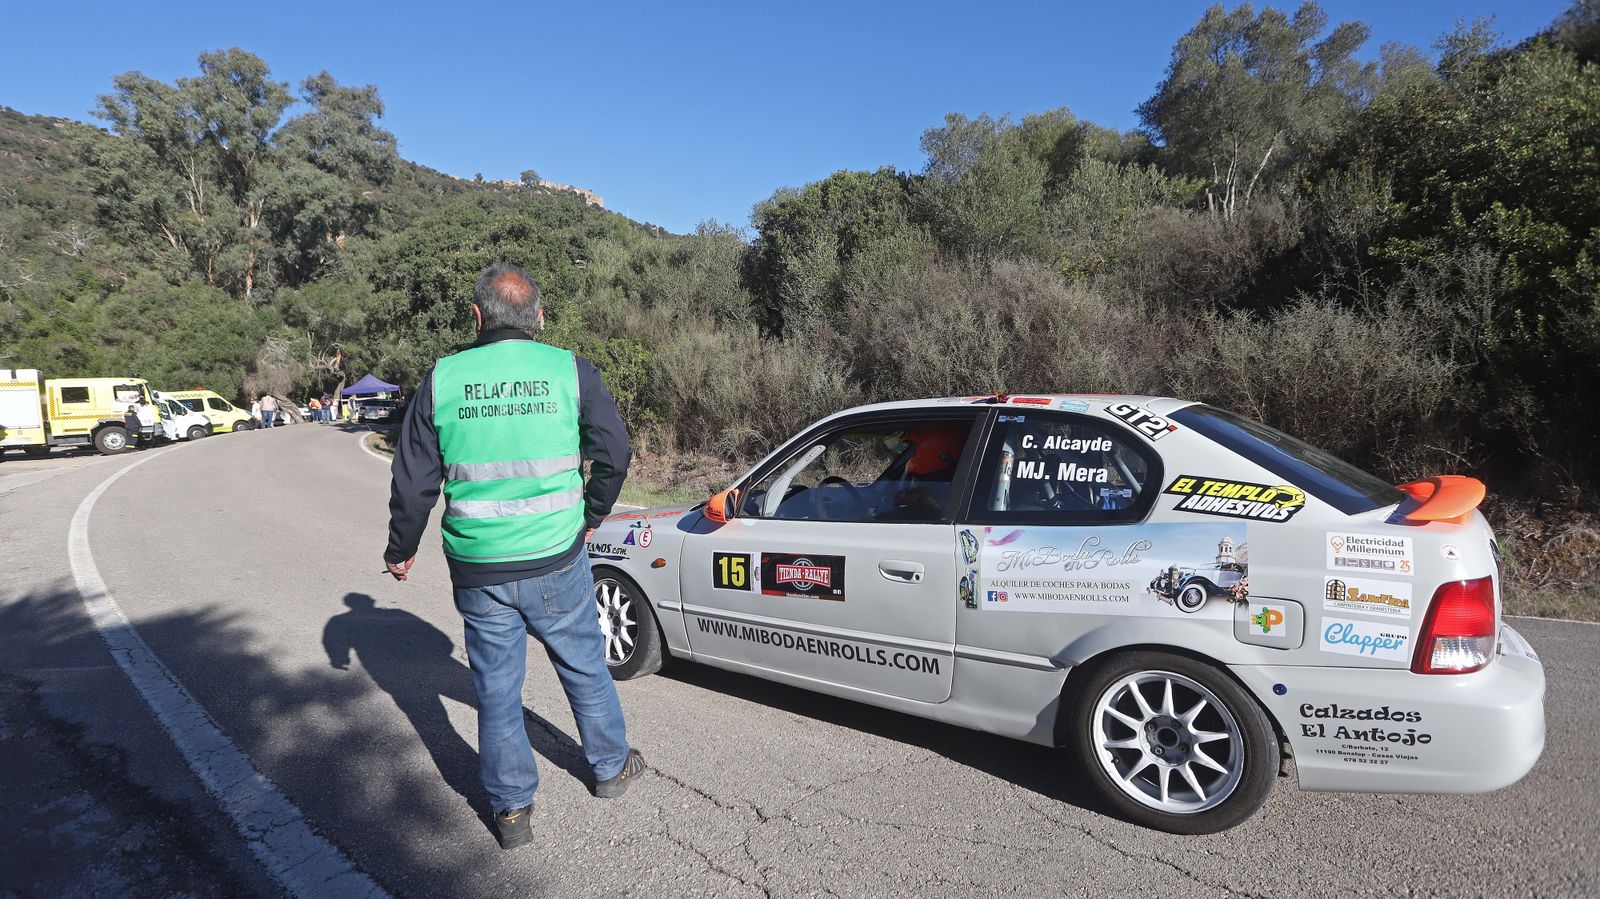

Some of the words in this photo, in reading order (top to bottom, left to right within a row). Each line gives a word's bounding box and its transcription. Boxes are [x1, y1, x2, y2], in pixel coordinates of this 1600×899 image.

[464, 381, 549, 401] RELACIONES
[458, 407, 479, 420] CON
[481, 401, 558, 418] CONCURSANTES
[1107, 403, 1178, 442] GT2i
[1022, 435, 1038, 449] C.
[1043, 435, 1113, 453] Alcayde
[1016, 461, 1050, 480] MJ.
[1057, 462, 1108, 483] Mera
[1174, 478, 1191, 494] EL
[1193, 480, 1277, 502] TEMPLO
[1182, 494, 1297, 522] ADHESIVOS
[643, 531, 650, 543] E
[1346, 536, 1404, 548] Electricidad
[997, 549, 1031, 572] Mi
[1084, 539, 1152, 570] Rolls
[1346, 545, 1405, 556] Millennium
[718, 556, 745, 587] 15
[779, 567, 802, 581] TIENDA
[804, 568, 829, 584] RALLYE
[1399, 559, 1411, 573] 25
[990, 580, 1028, 588] ALQUILER
[1030, 580, 1042, 588] DE
[1042, 581, 1075, 589] COCHES
[1076, 581, 1099, 589] PARA
[1100, 582, 1130, 590] BODAS
[1014, 591, 1129, 603] WWW.MIBODAENROLLS.COM
[1266, 610, 1283, 629] P
[1324, 622, 1404, 656] Clapper
[1379, 631, 1408, 640] GRUPO
[697, 617, 940, 675] WWW.MIBODAENROLLS.COM
[1299, 703, 1422, 723] Calzados
[1300, 723, 1326, 738] El
[1333, 725, 1432, 746] Antojo
